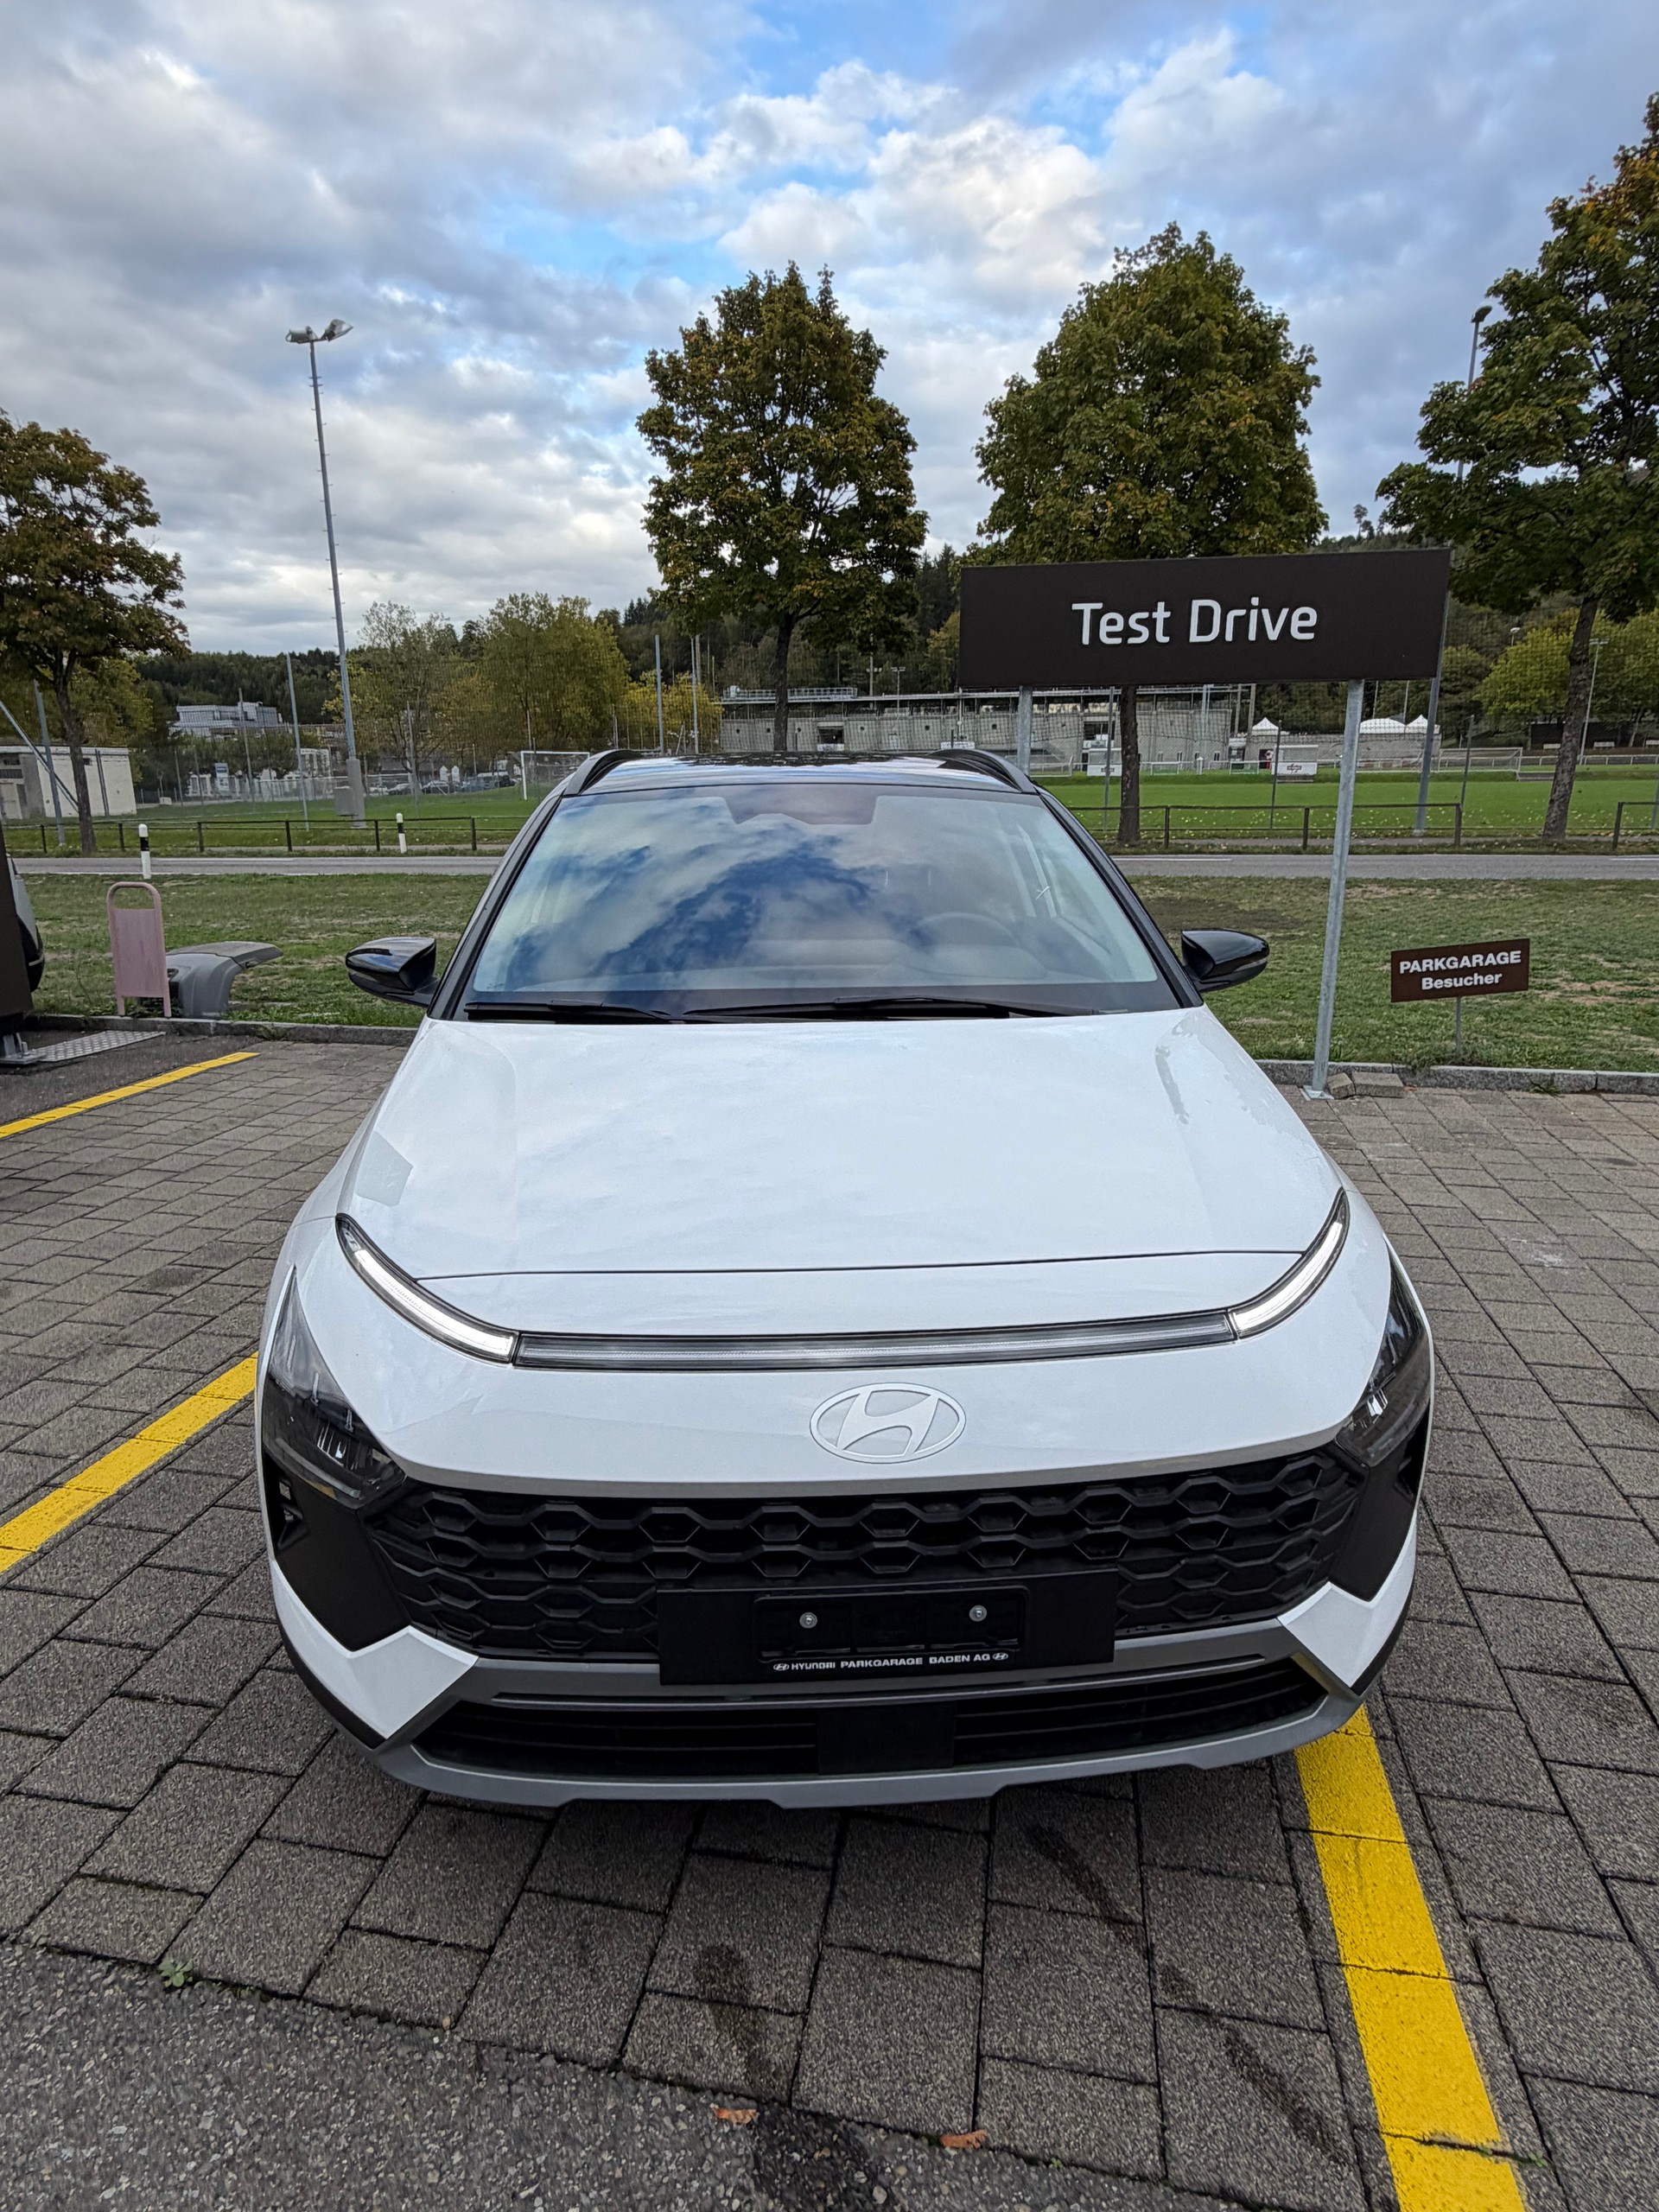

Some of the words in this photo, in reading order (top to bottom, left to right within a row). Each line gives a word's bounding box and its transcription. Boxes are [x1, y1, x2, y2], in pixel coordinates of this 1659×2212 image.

[1071, 601, 1172, 645] Test
[1189, 596, 1318, 643] Drive
[1399, 950, 1522, 974] PARKGARAGE
[1421, 973, 1503, 990] Besucher
[791, 1662, 836, 1670] HYUNDAI
[840, 1657, 923, 1669] PARKGARAGE
[929, 1655, 970, 1664] BADEN
